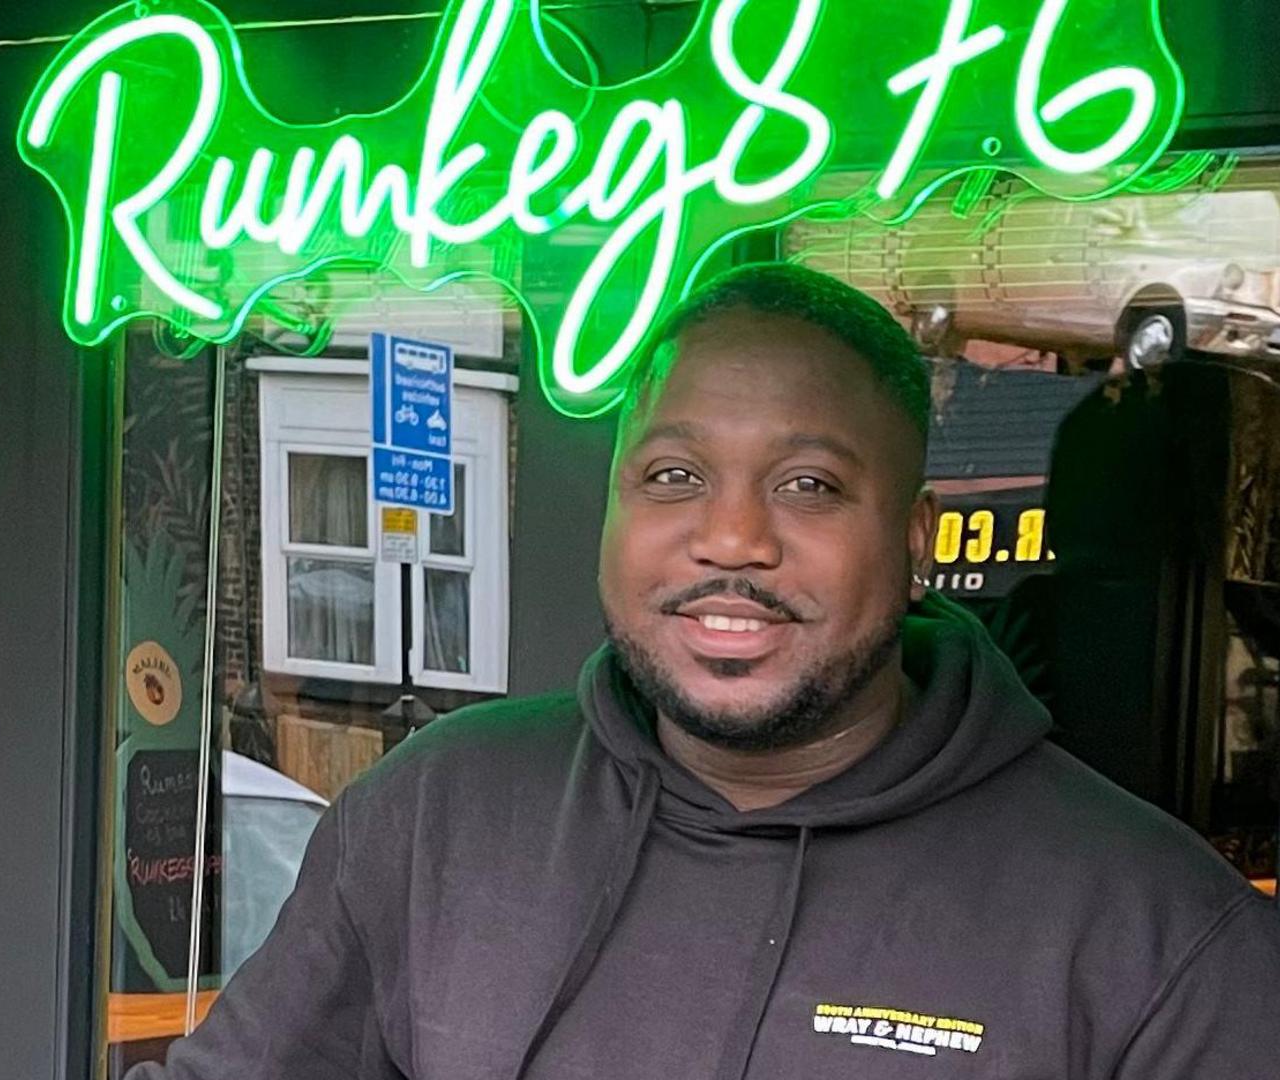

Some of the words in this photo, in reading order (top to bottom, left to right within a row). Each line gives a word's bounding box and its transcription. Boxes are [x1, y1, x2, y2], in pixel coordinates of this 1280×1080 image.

[28, 0, 1158, 394] Rumkeg876
[814, 1015, 872, 1034] WRAY
[874, 1020, 894, 1036] &
[895, 1023, 982, 1053] NEPHEW
